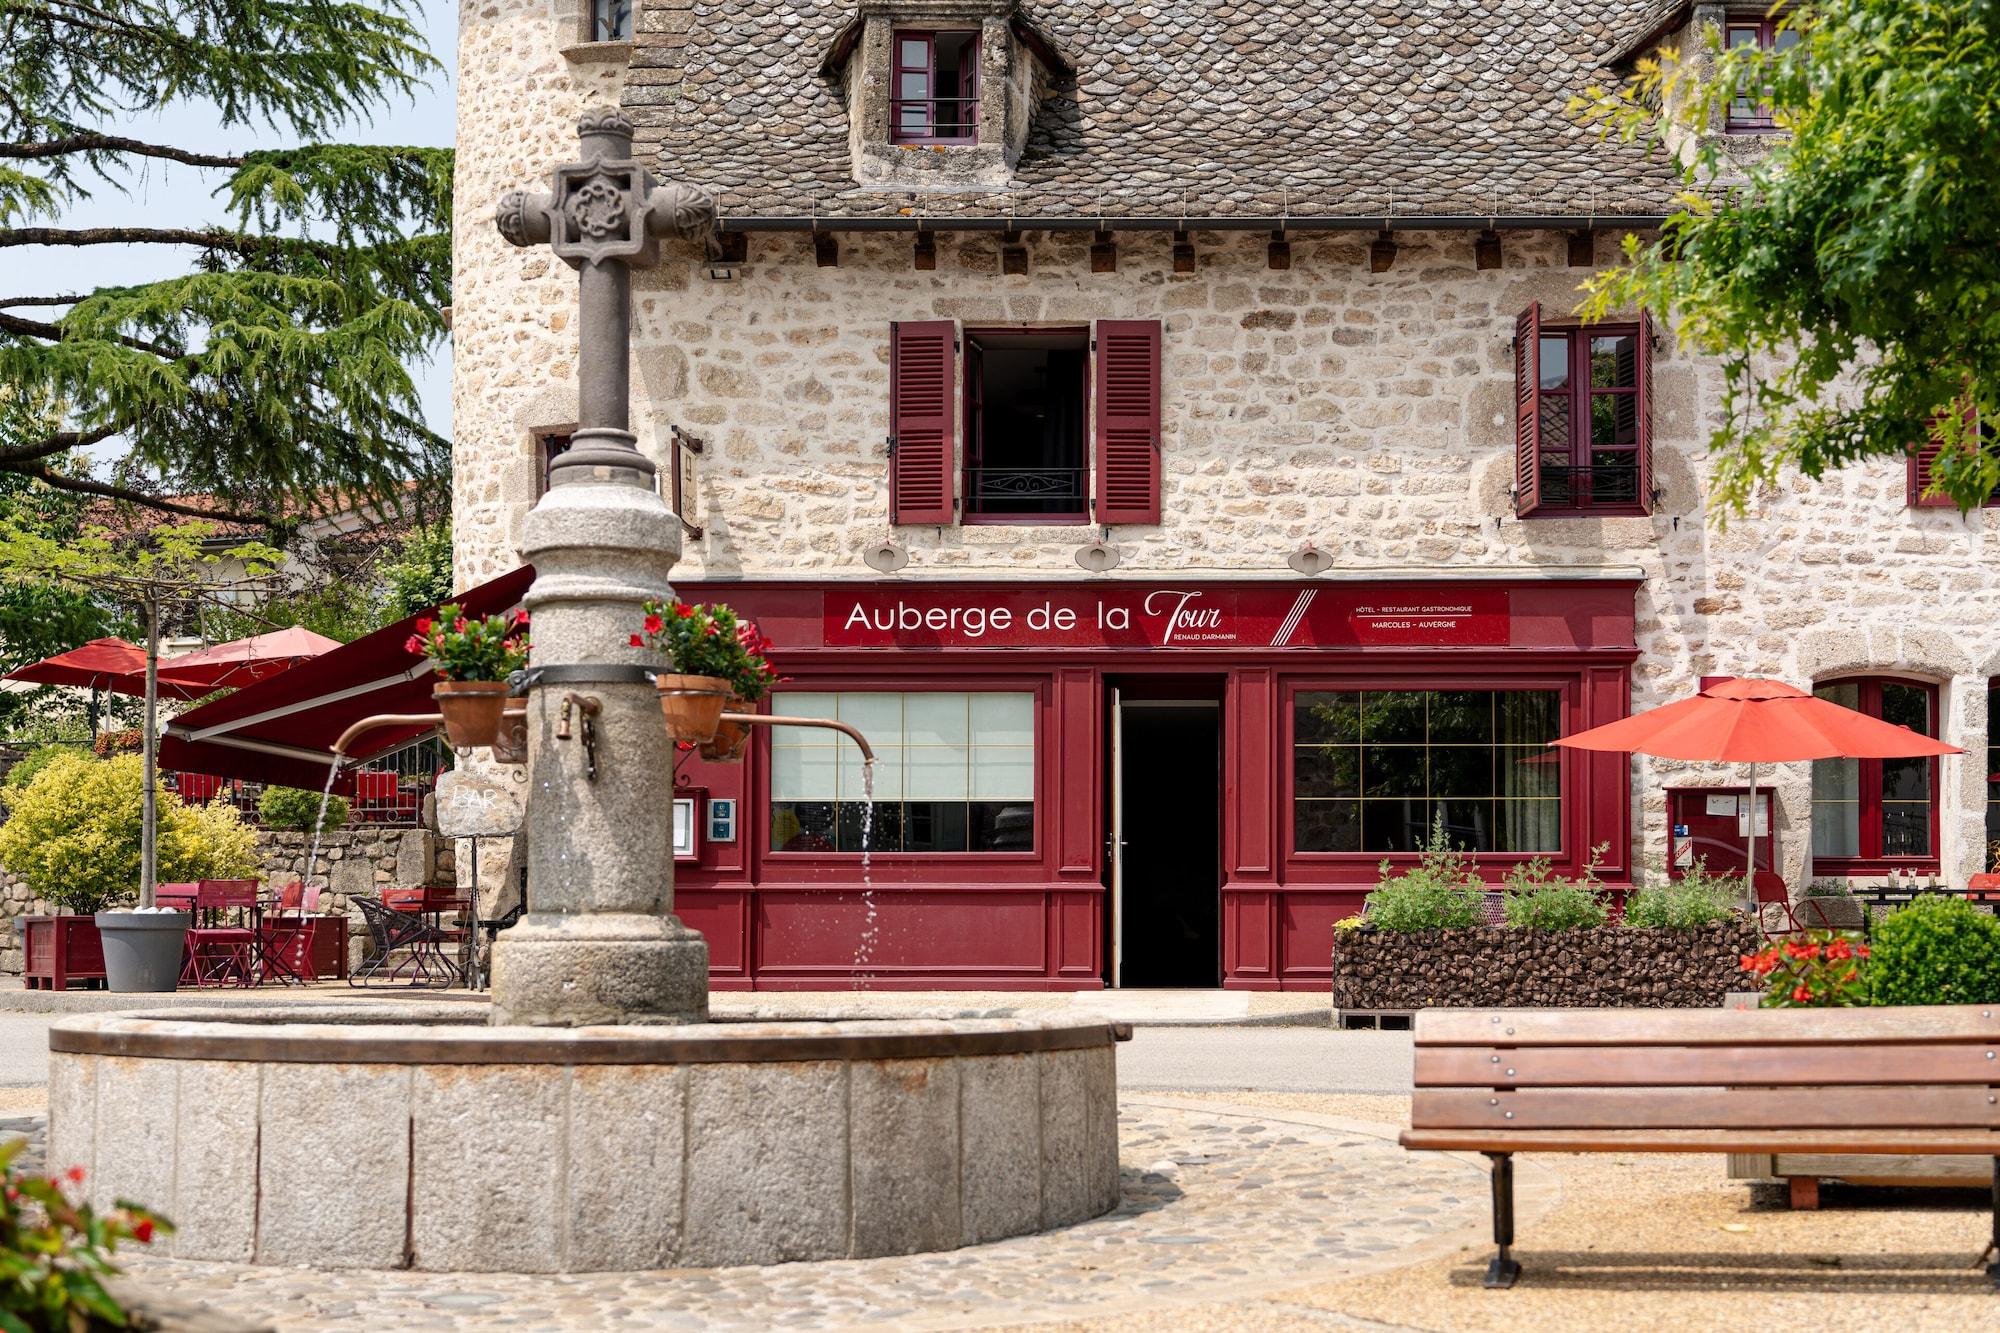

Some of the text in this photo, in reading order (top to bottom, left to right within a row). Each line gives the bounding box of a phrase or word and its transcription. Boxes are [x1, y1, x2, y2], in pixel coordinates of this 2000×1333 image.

[844, 590, 1222, 645] Auberge de la Tour
[1371, 621, 1411, 629] MARCOLES
[1418, 620, 1457, 629] AUVERGNE
[1173, 633, 1237, 641] RENAUD DARMANIN
[453, 784, 498, 809] BAR
